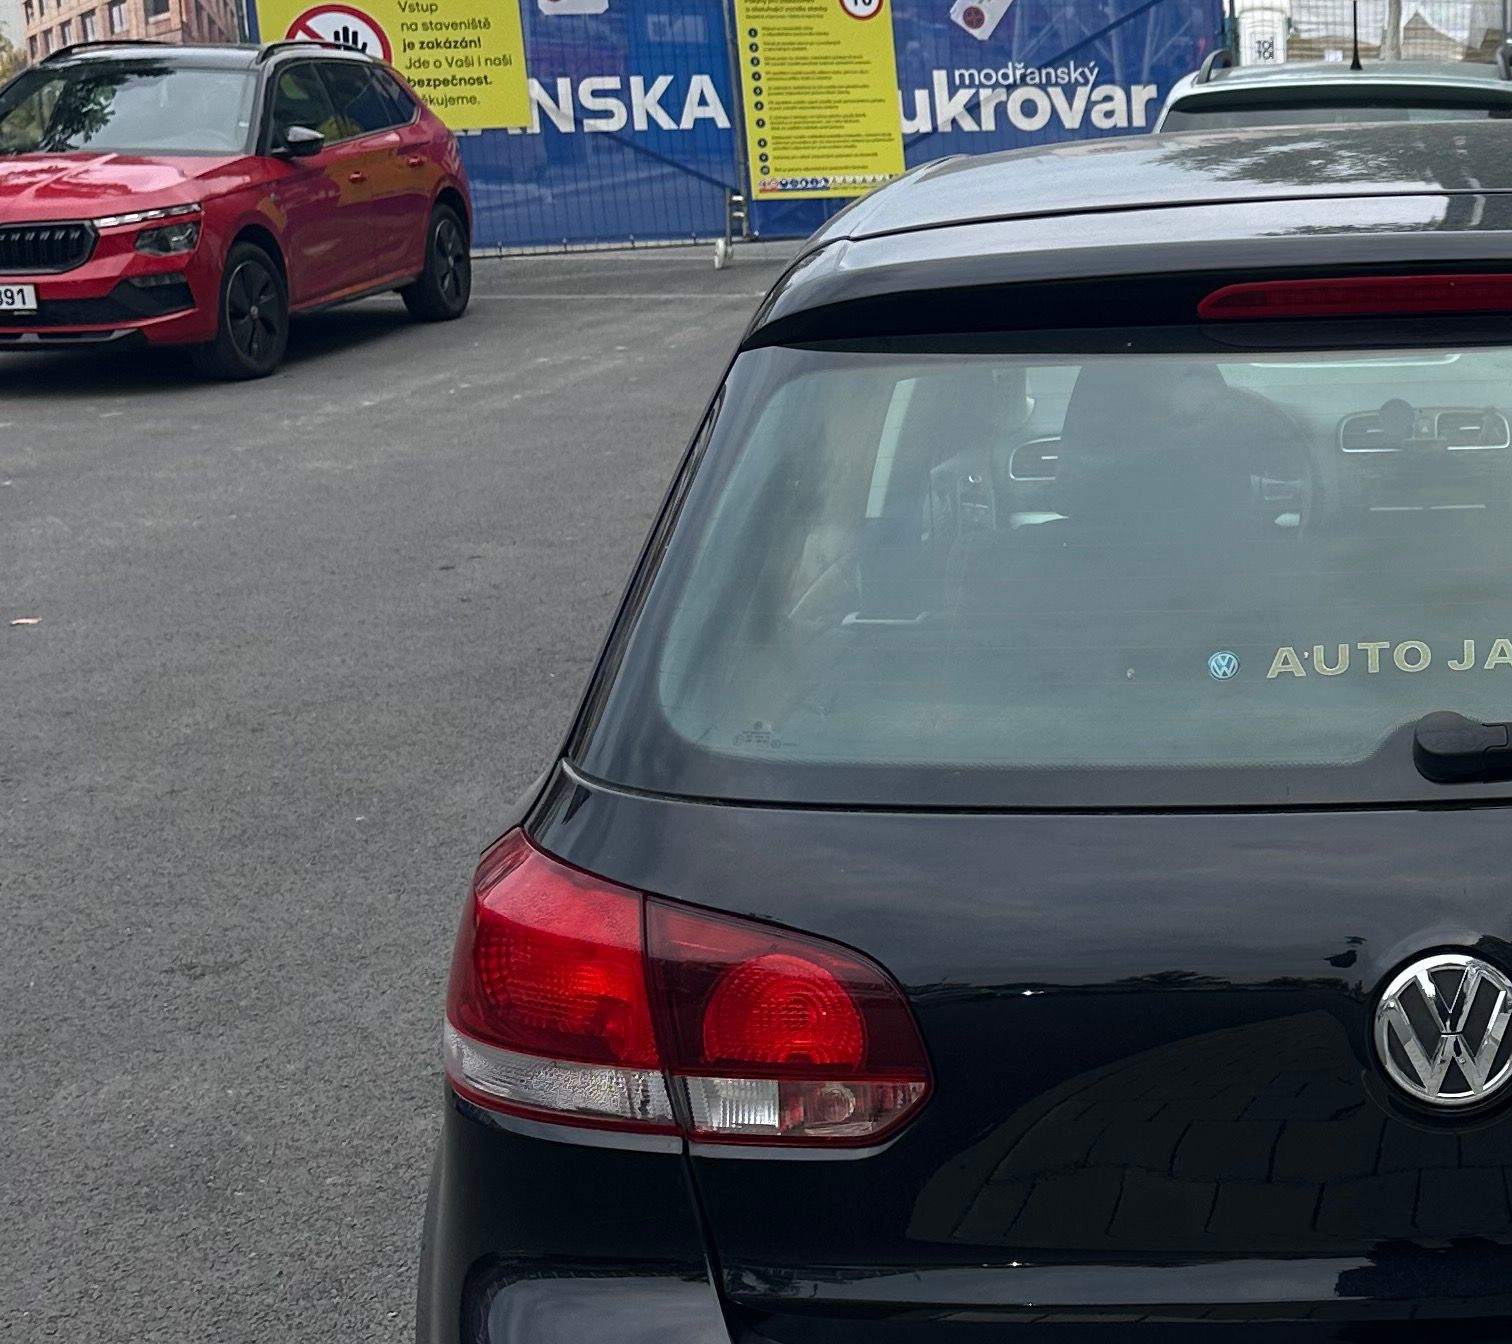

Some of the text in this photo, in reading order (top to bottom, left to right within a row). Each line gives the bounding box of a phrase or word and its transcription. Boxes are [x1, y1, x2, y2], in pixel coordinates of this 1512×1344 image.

[397, 0, 439, 15] Vstup
[401, 17, 492, 32] na staveniště
[402, 40, 416, 53] je
[405, 58, 430, 70] Jde
[433, 60, 443, 69] o
[445, 55, 475, 68] Vaši
[484, 54, 513, 67] naši
[954, 60, 1100, 87] modřanský
[422, 93, 481, 108] ěkujeme.
[508, 73, 732, 134] NSKA
[1266, 639, 1433, 679] AUTO
